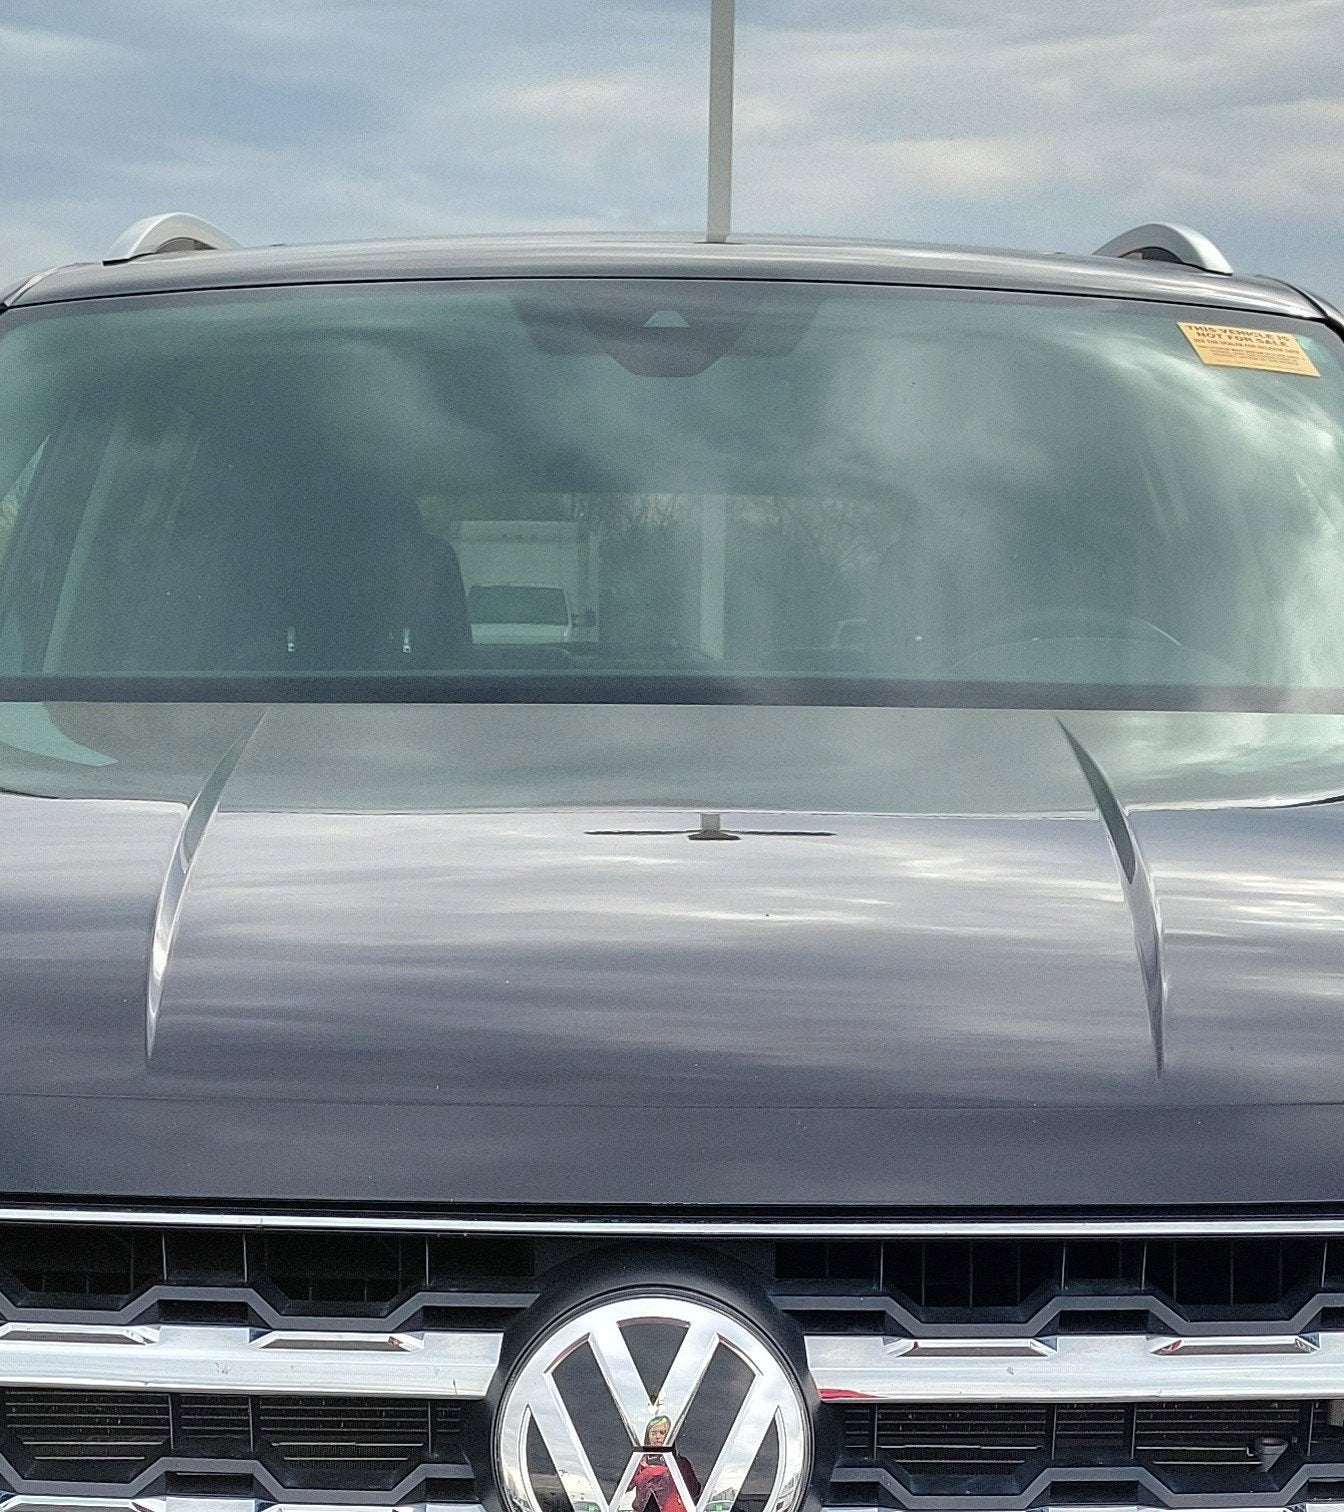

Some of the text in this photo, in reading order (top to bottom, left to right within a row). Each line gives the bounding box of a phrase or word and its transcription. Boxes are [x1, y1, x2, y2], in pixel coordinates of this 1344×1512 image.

[1217, 328, 1272, 339] VEHICLE
[1227, 334, 1253, 342] FOR
[1256, 338, 1290, 347] SALE
